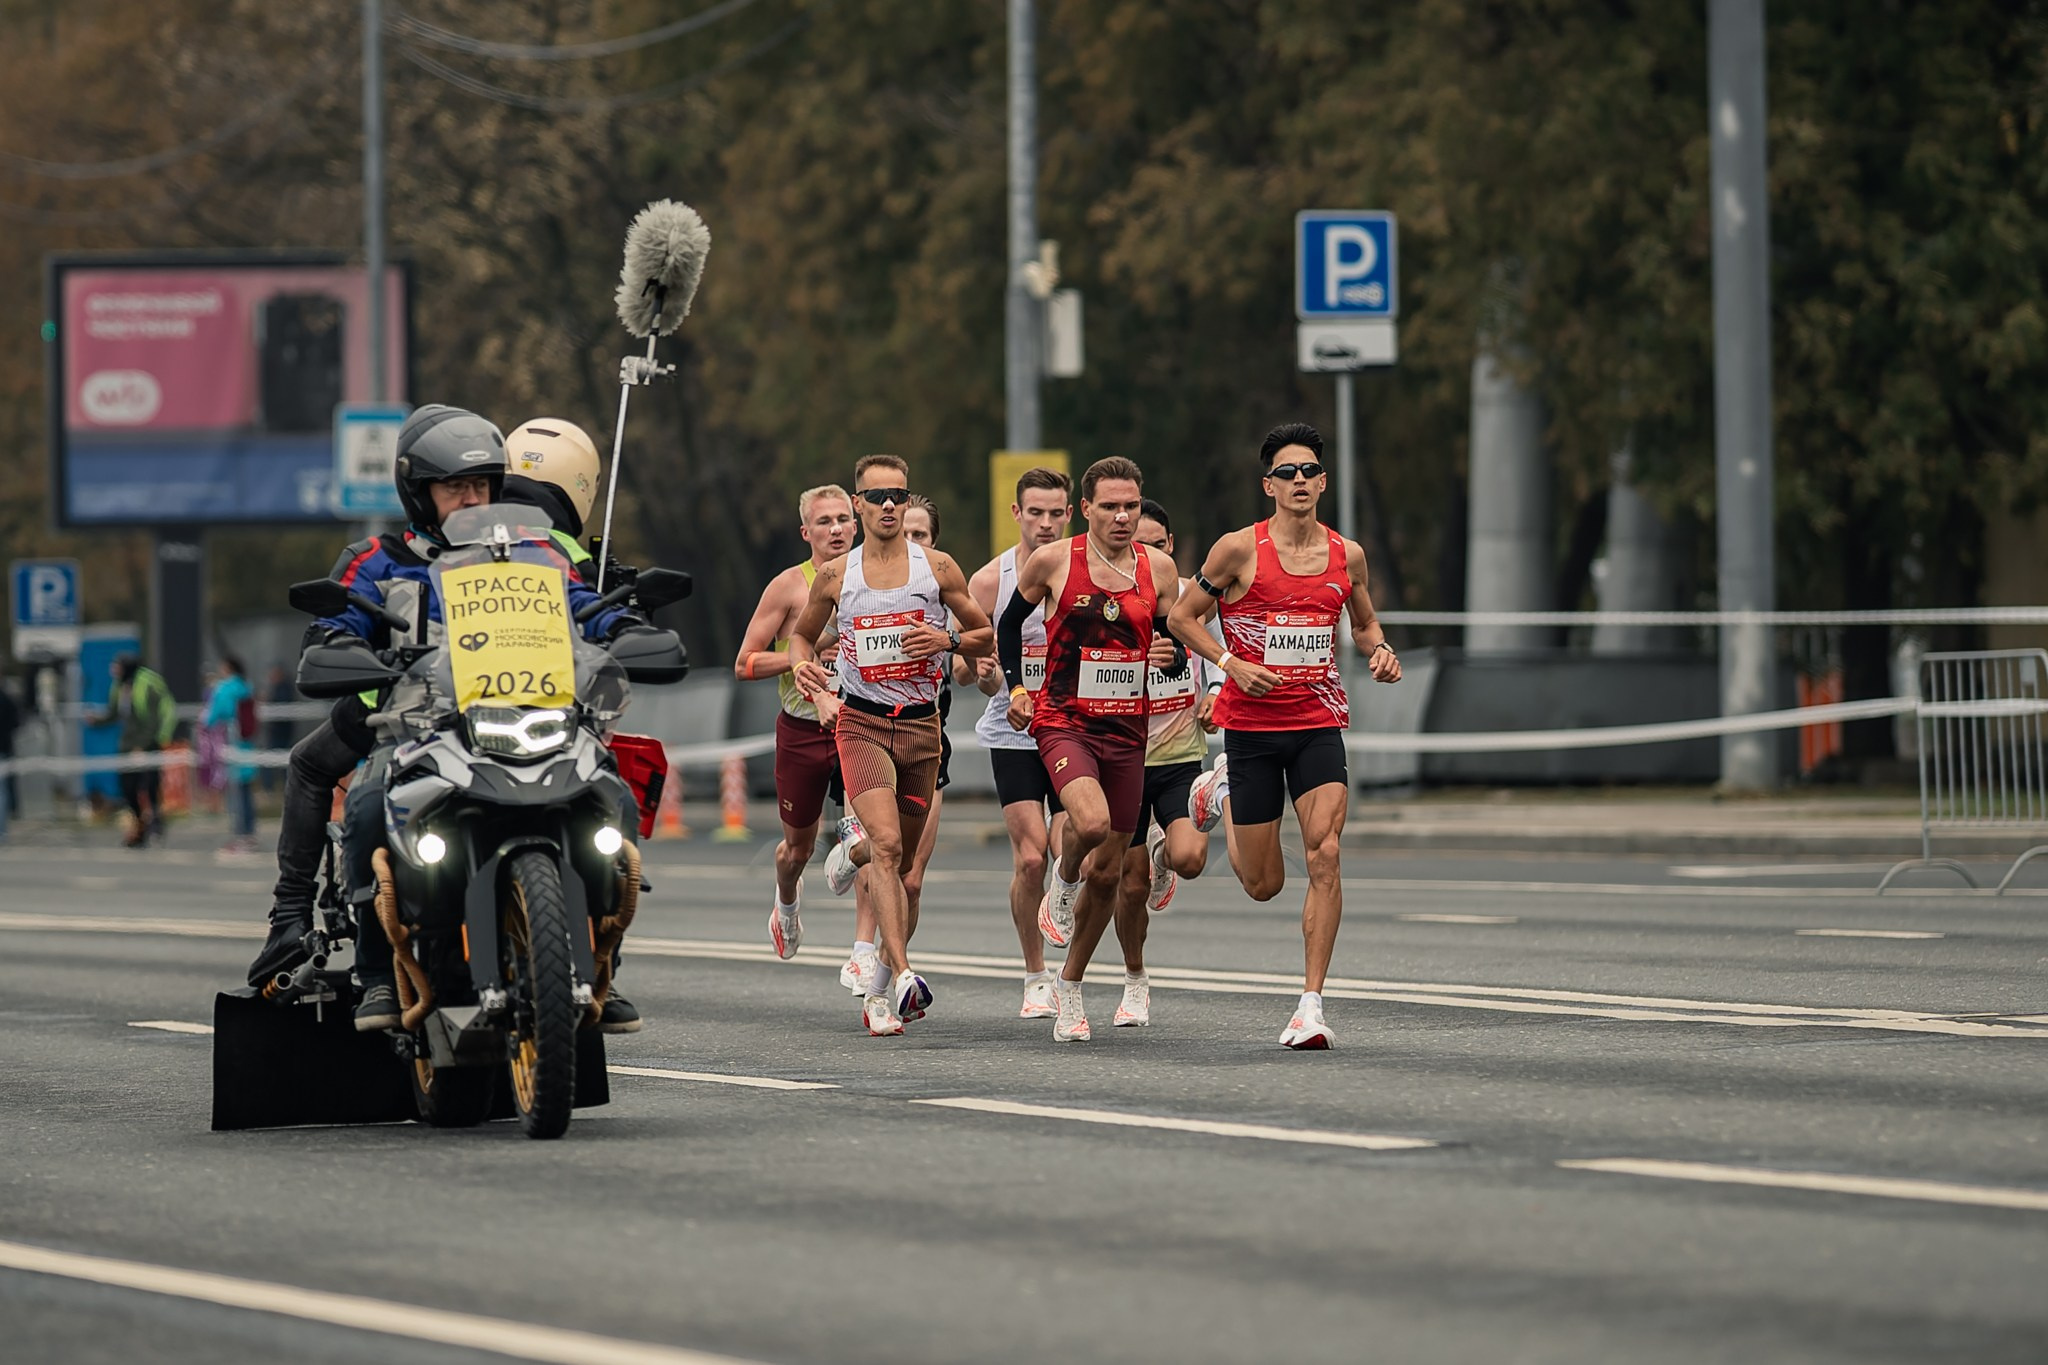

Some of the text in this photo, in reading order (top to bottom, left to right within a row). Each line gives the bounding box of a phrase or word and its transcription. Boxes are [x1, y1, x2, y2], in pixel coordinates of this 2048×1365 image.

[1325, 224, 1377, 308] P
[456, 575, 551, 598] ТРАССА
[451, 596, 562, 620] ПРОПУСК
[866, 633, 903, 651] ГУРЖ
[1268, 633, 1330, 653] АХМАДЕЕВ
[476, 670, 556, 699] 2026
[1096, 669, 1135, 684] ПОПОВ
